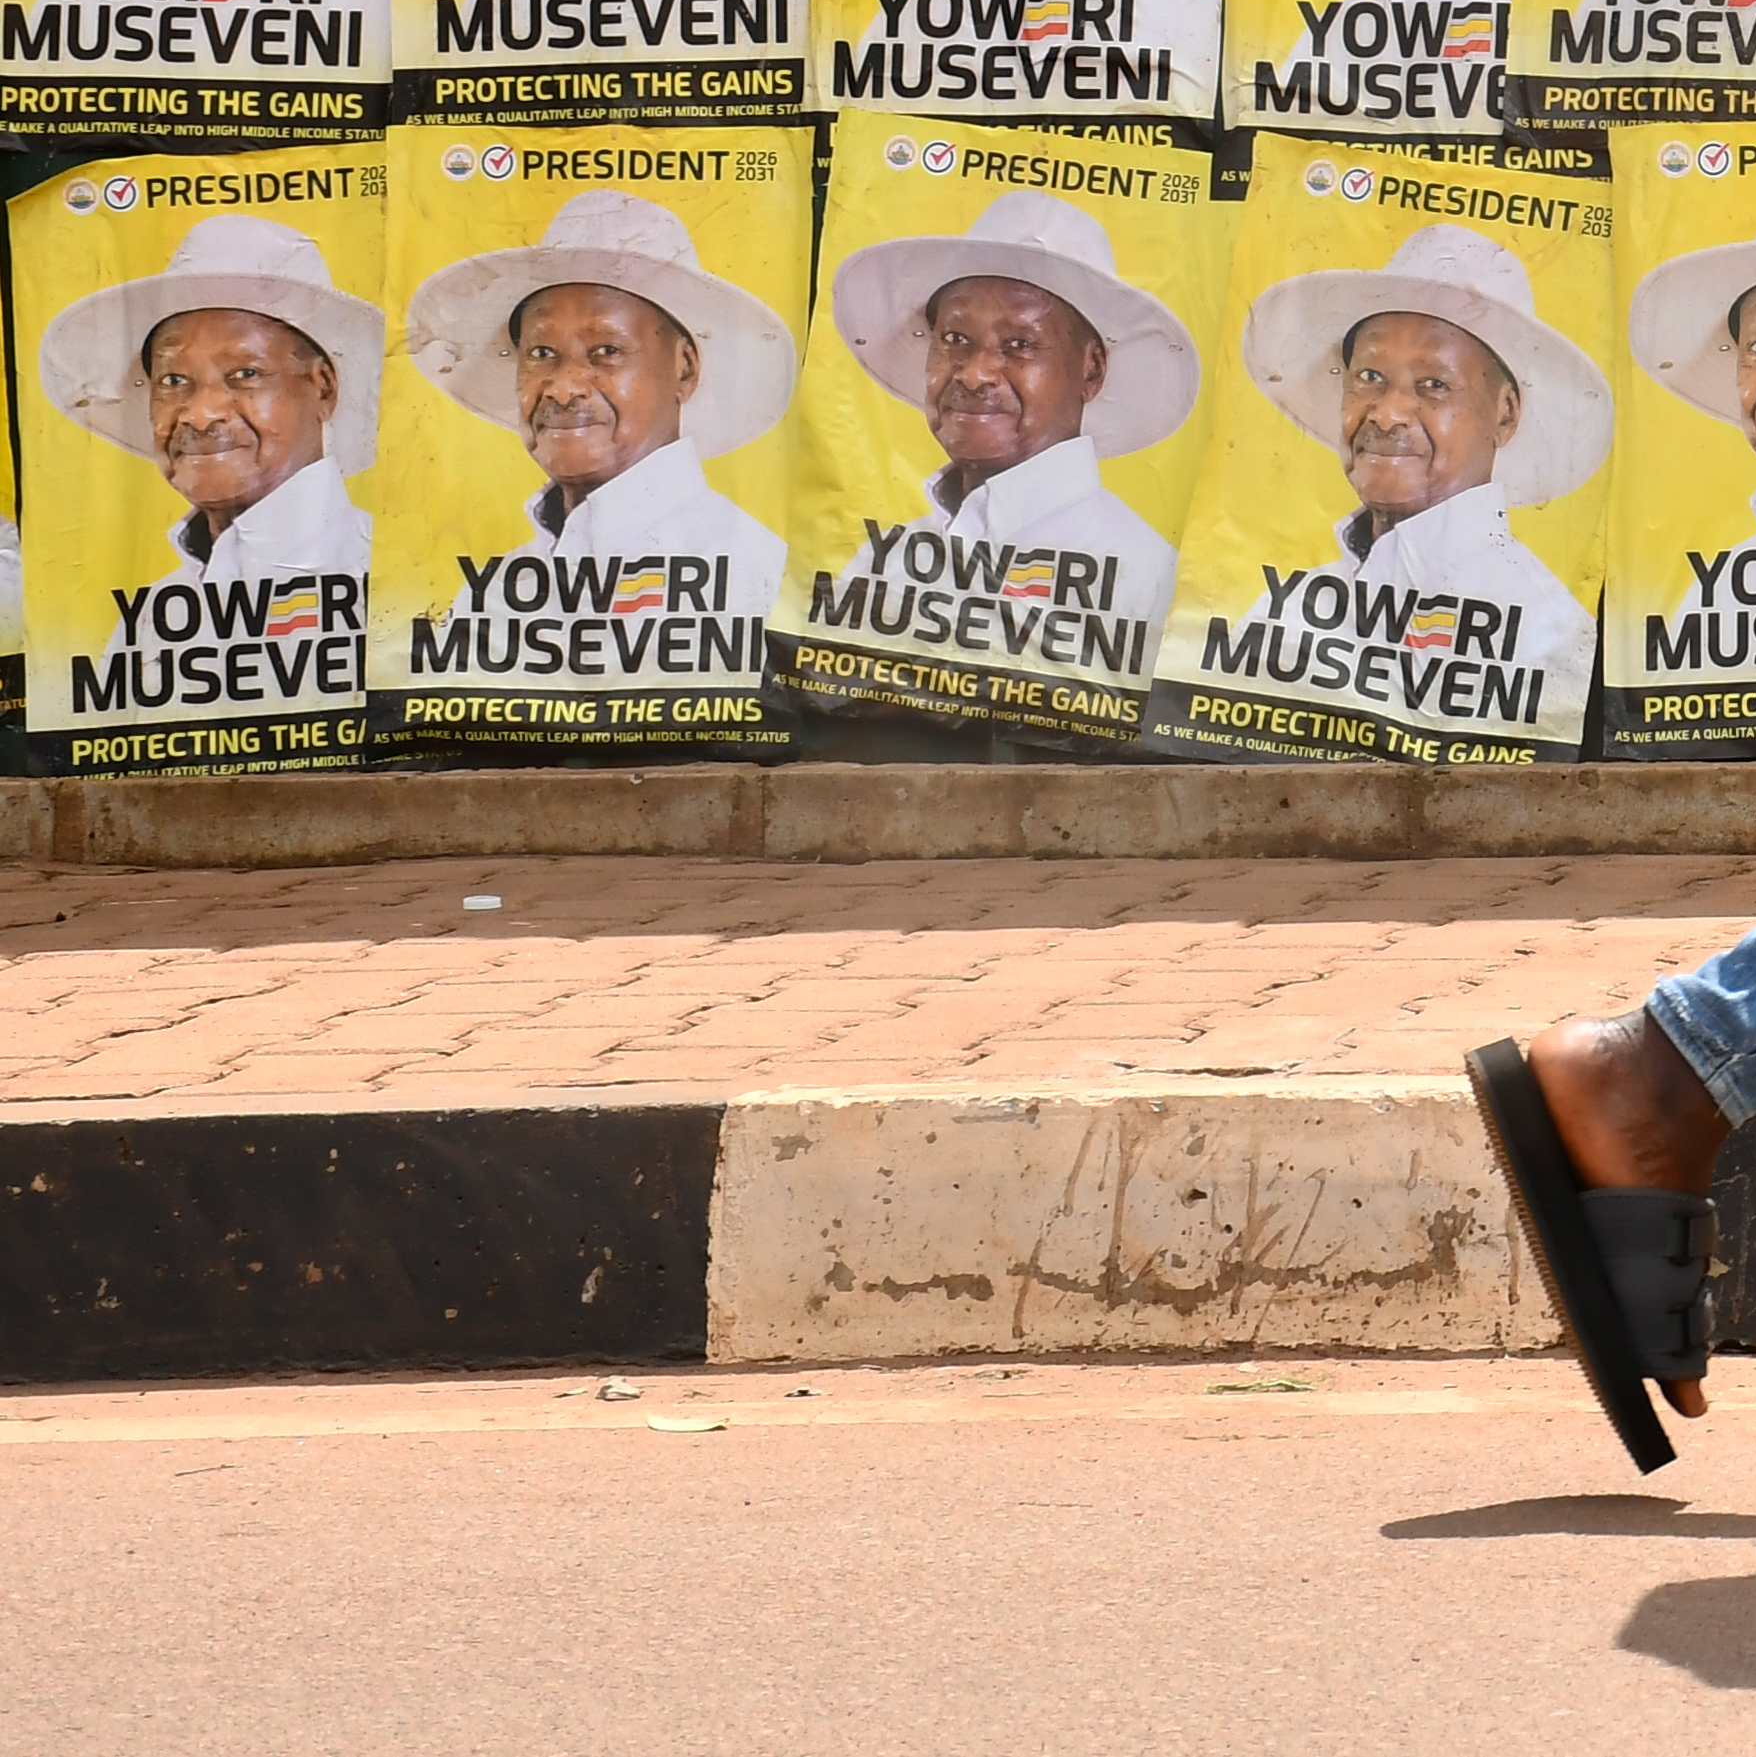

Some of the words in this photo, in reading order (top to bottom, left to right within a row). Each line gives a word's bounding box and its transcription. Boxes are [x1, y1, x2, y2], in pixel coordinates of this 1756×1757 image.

[3, 4, 361, 67] MUSEVENI
[437, 74, 621, 104] PROTECTING
[631, 72, 691, 96] THE
[702, 70, 792, 96] GAINS
[834, 41, 1170, 100] MUSEVENI
[147, 168, 354, 208] PRESIDENT
[523, 150, 729, 180] PRESIDENT
[962, 149, 1157, 199] PRESIDENT
[1379, 176, 1579, 231] PRESIDENT
[411, 617, 762, 674] MUSEVENI
[808, 571, 1147, 675] MUSEVENI
[1202, 618, 1543, 724] MUSEVENI
[405, 698, 596, 723] PROTECTING
[607, 699, 665, 723] THE
[673, 698, 761, 721] GAINS
